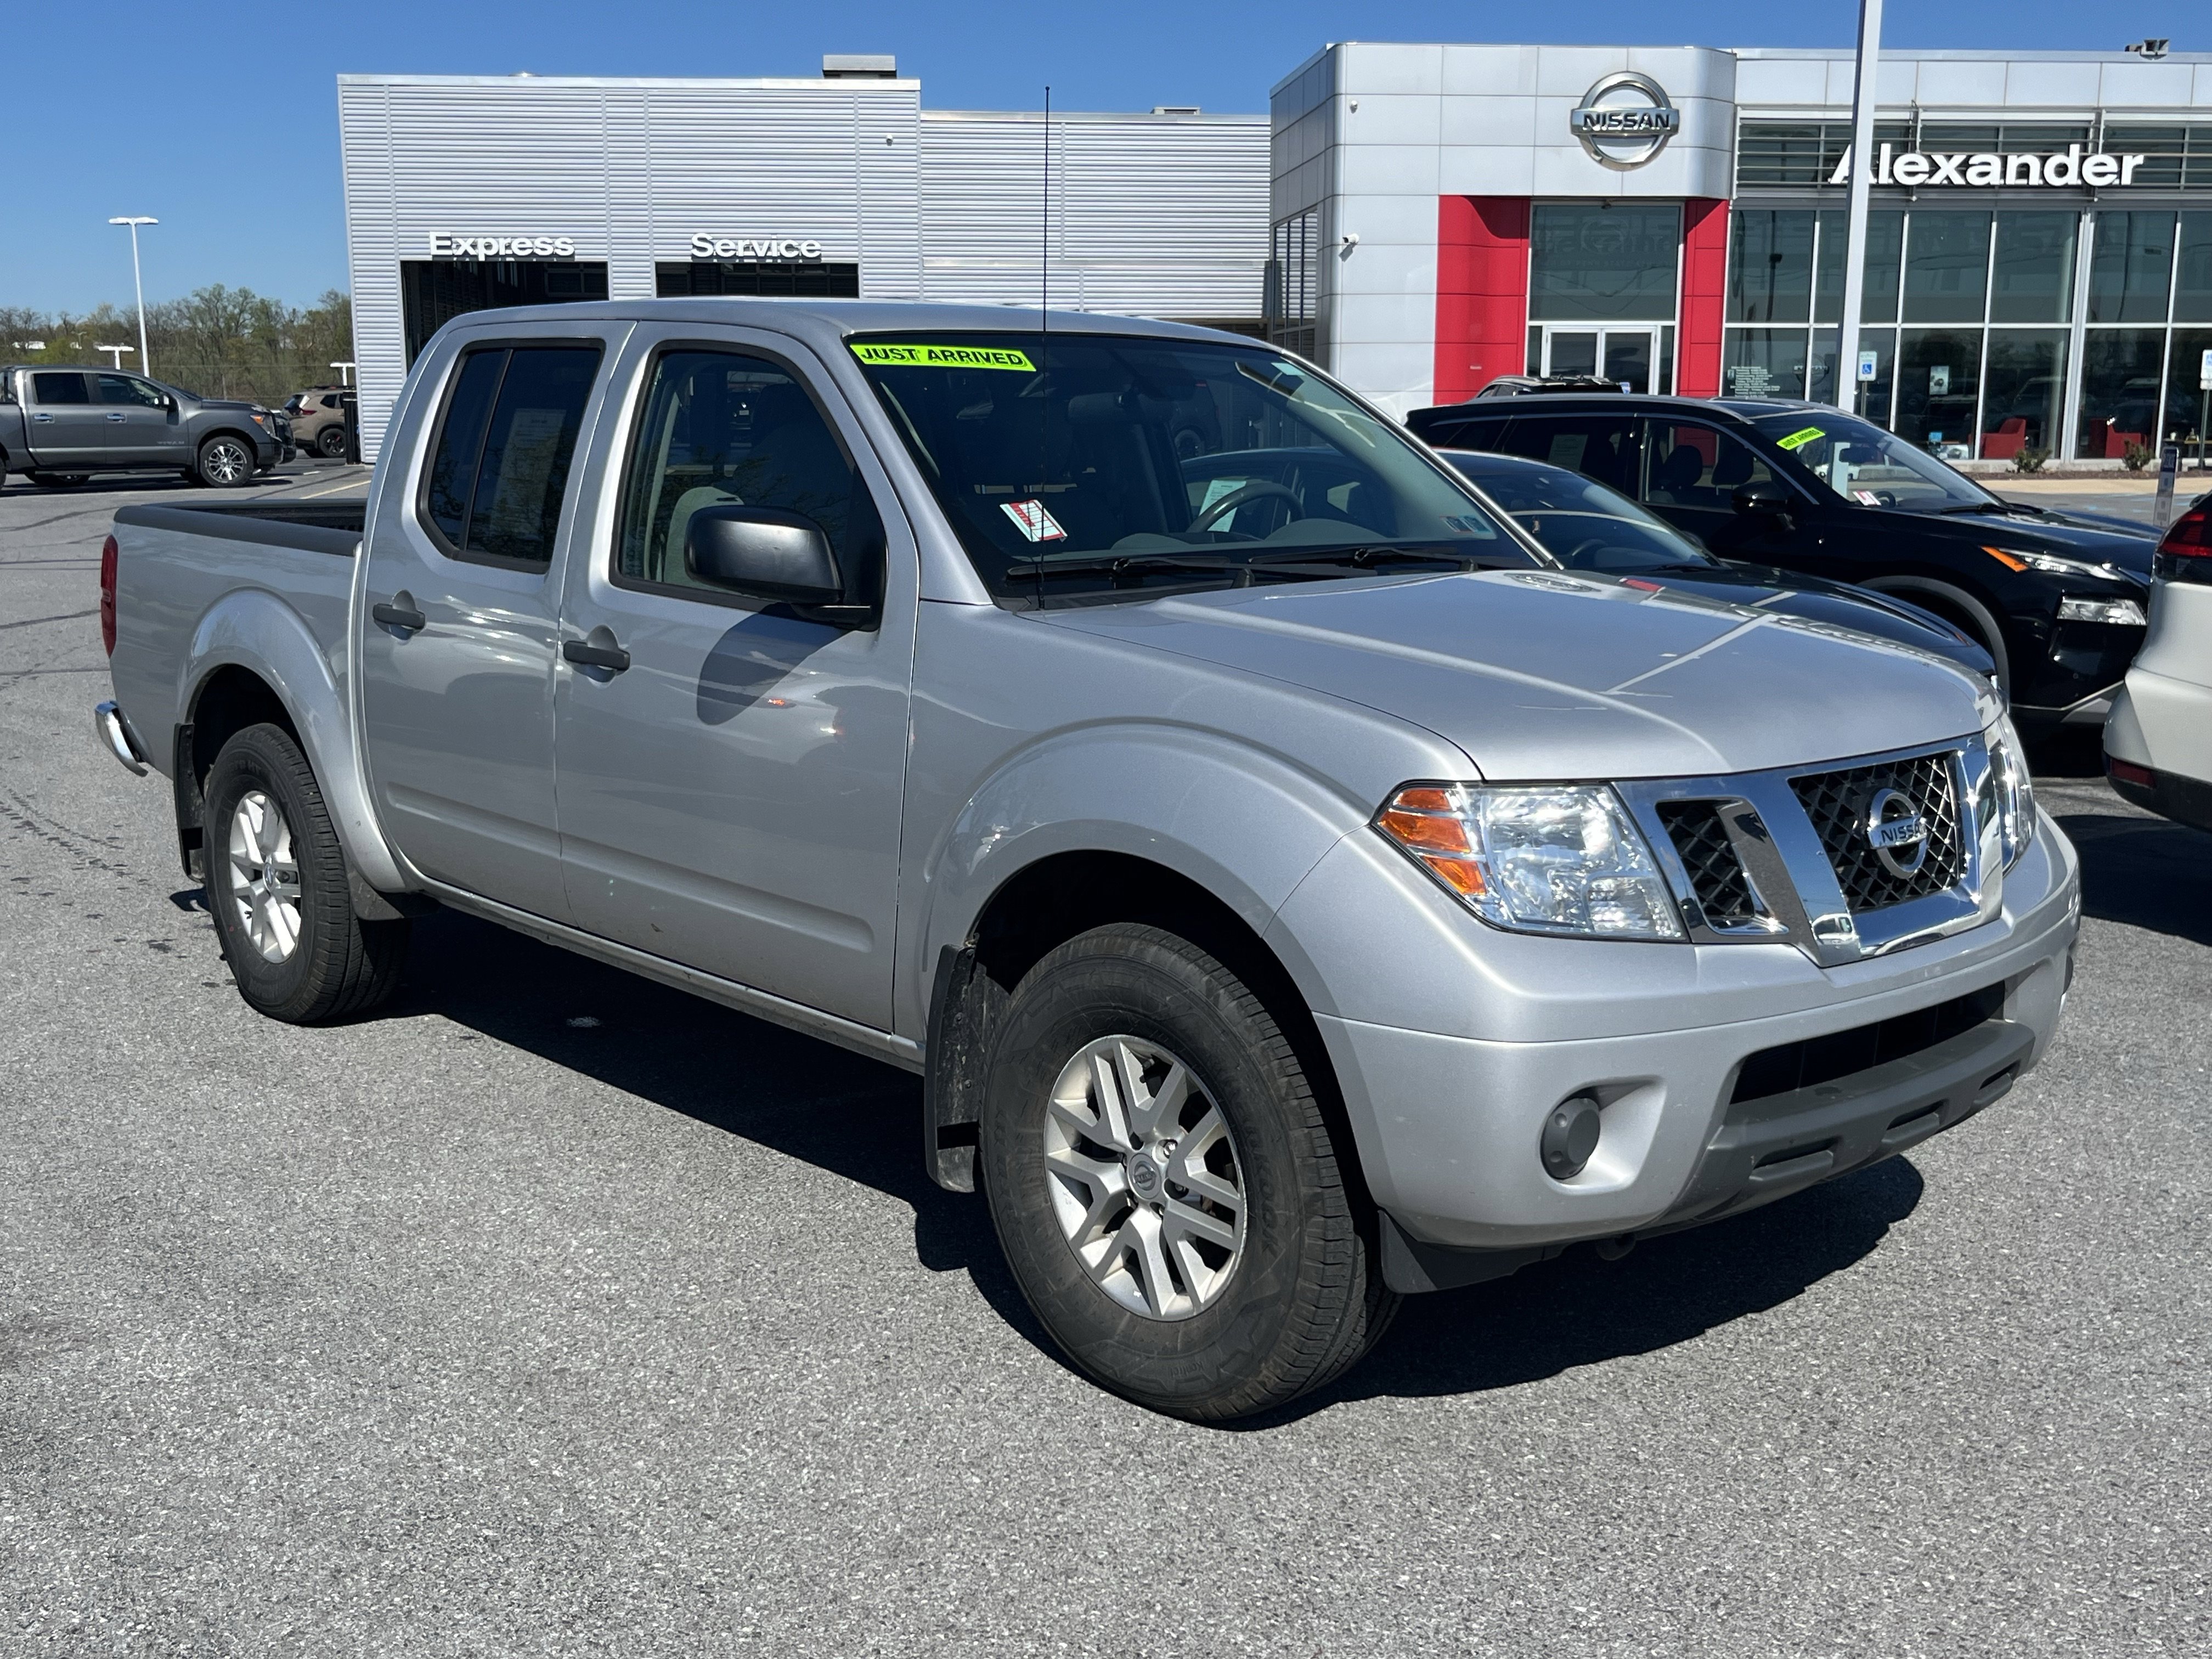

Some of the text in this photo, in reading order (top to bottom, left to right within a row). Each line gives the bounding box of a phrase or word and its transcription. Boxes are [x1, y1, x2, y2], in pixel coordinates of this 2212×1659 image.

[1583, 112, 1671, 131] NISSAN
[1829, 143, 2145, 187] Alexander
[430, 231, 575, 261] Express
[691, 233, 822, 258] Service
[860, 347, 1026, 366] JUST ARRIVED
